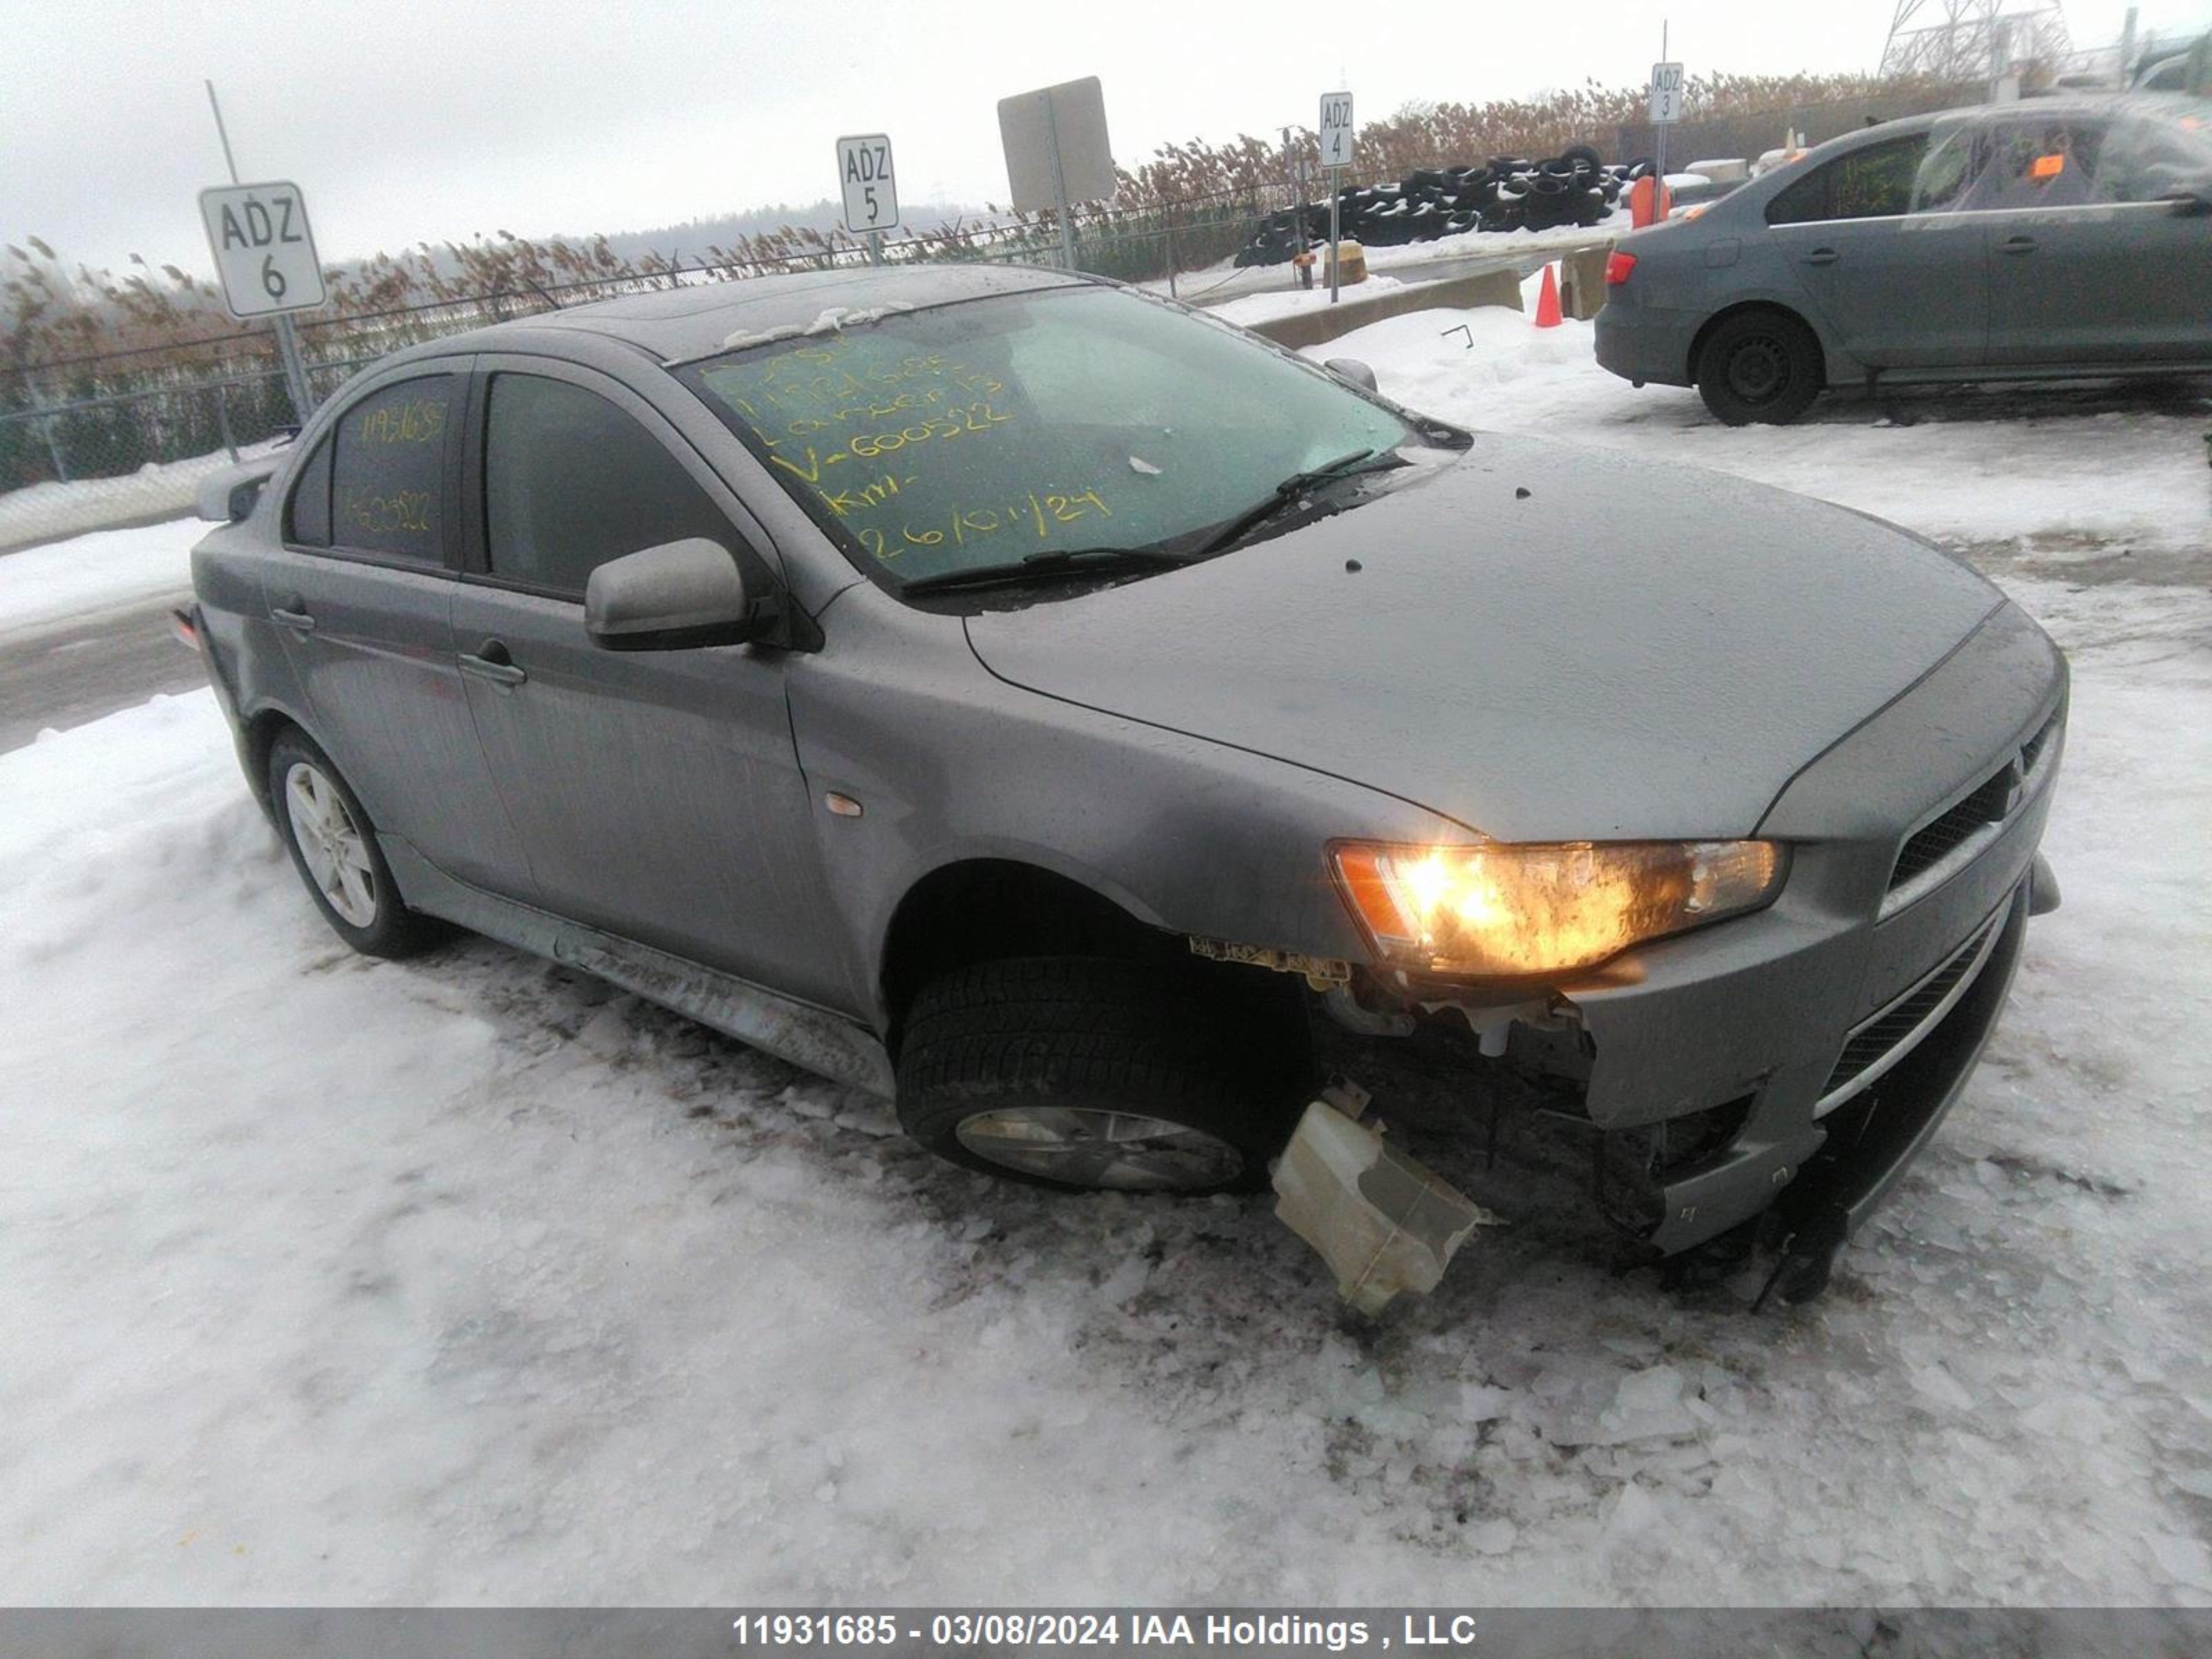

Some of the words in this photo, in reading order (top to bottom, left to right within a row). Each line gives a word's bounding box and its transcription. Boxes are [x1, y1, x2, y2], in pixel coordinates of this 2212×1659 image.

[1654, 70, 1680, 91] ADZ
[1324, 101, 1349, 129] ADZ
[1662, 95, 1670, 115] 3
[1332, 132, 1340, 158] 4
[847, 146, 889, 183] ADZ
[864, 187, 878, 221] 5
[221, 196, 302, 250] ADZ
[261, 253, 286, 298] 6
